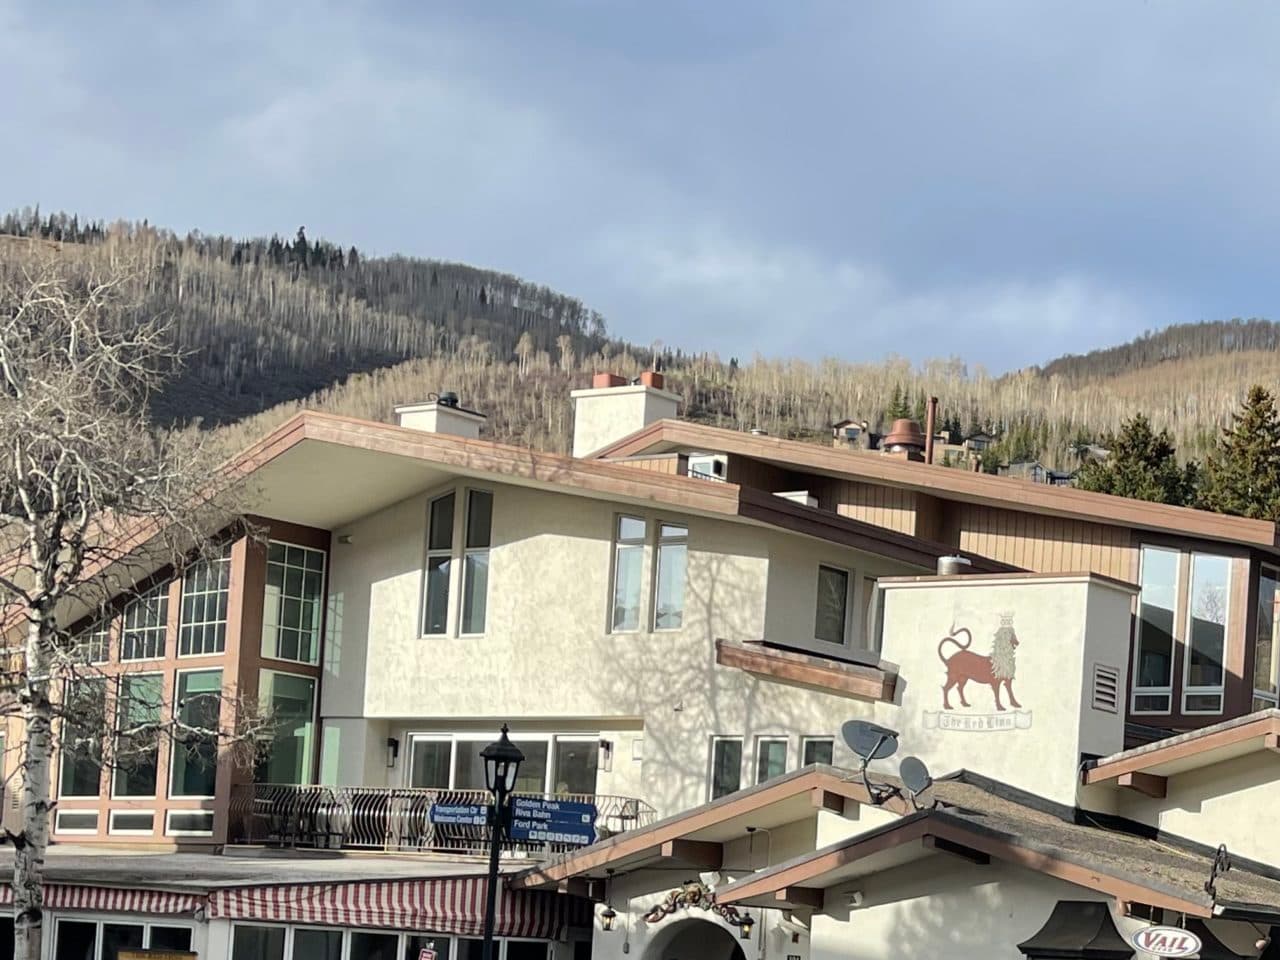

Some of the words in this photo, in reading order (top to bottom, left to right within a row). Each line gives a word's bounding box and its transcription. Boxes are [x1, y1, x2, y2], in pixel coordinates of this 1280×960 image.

[515, 798, 541, 808] Golden
[542, 801, 560, 810] Peak
[515, 807, 531, 817] Riva
[532, 809, 551, 819] Bahn
[513, 819, 531, 829] Ford
[531, 821, 549, 830] Park
[1144, 931, 1189, 951] VAIL
